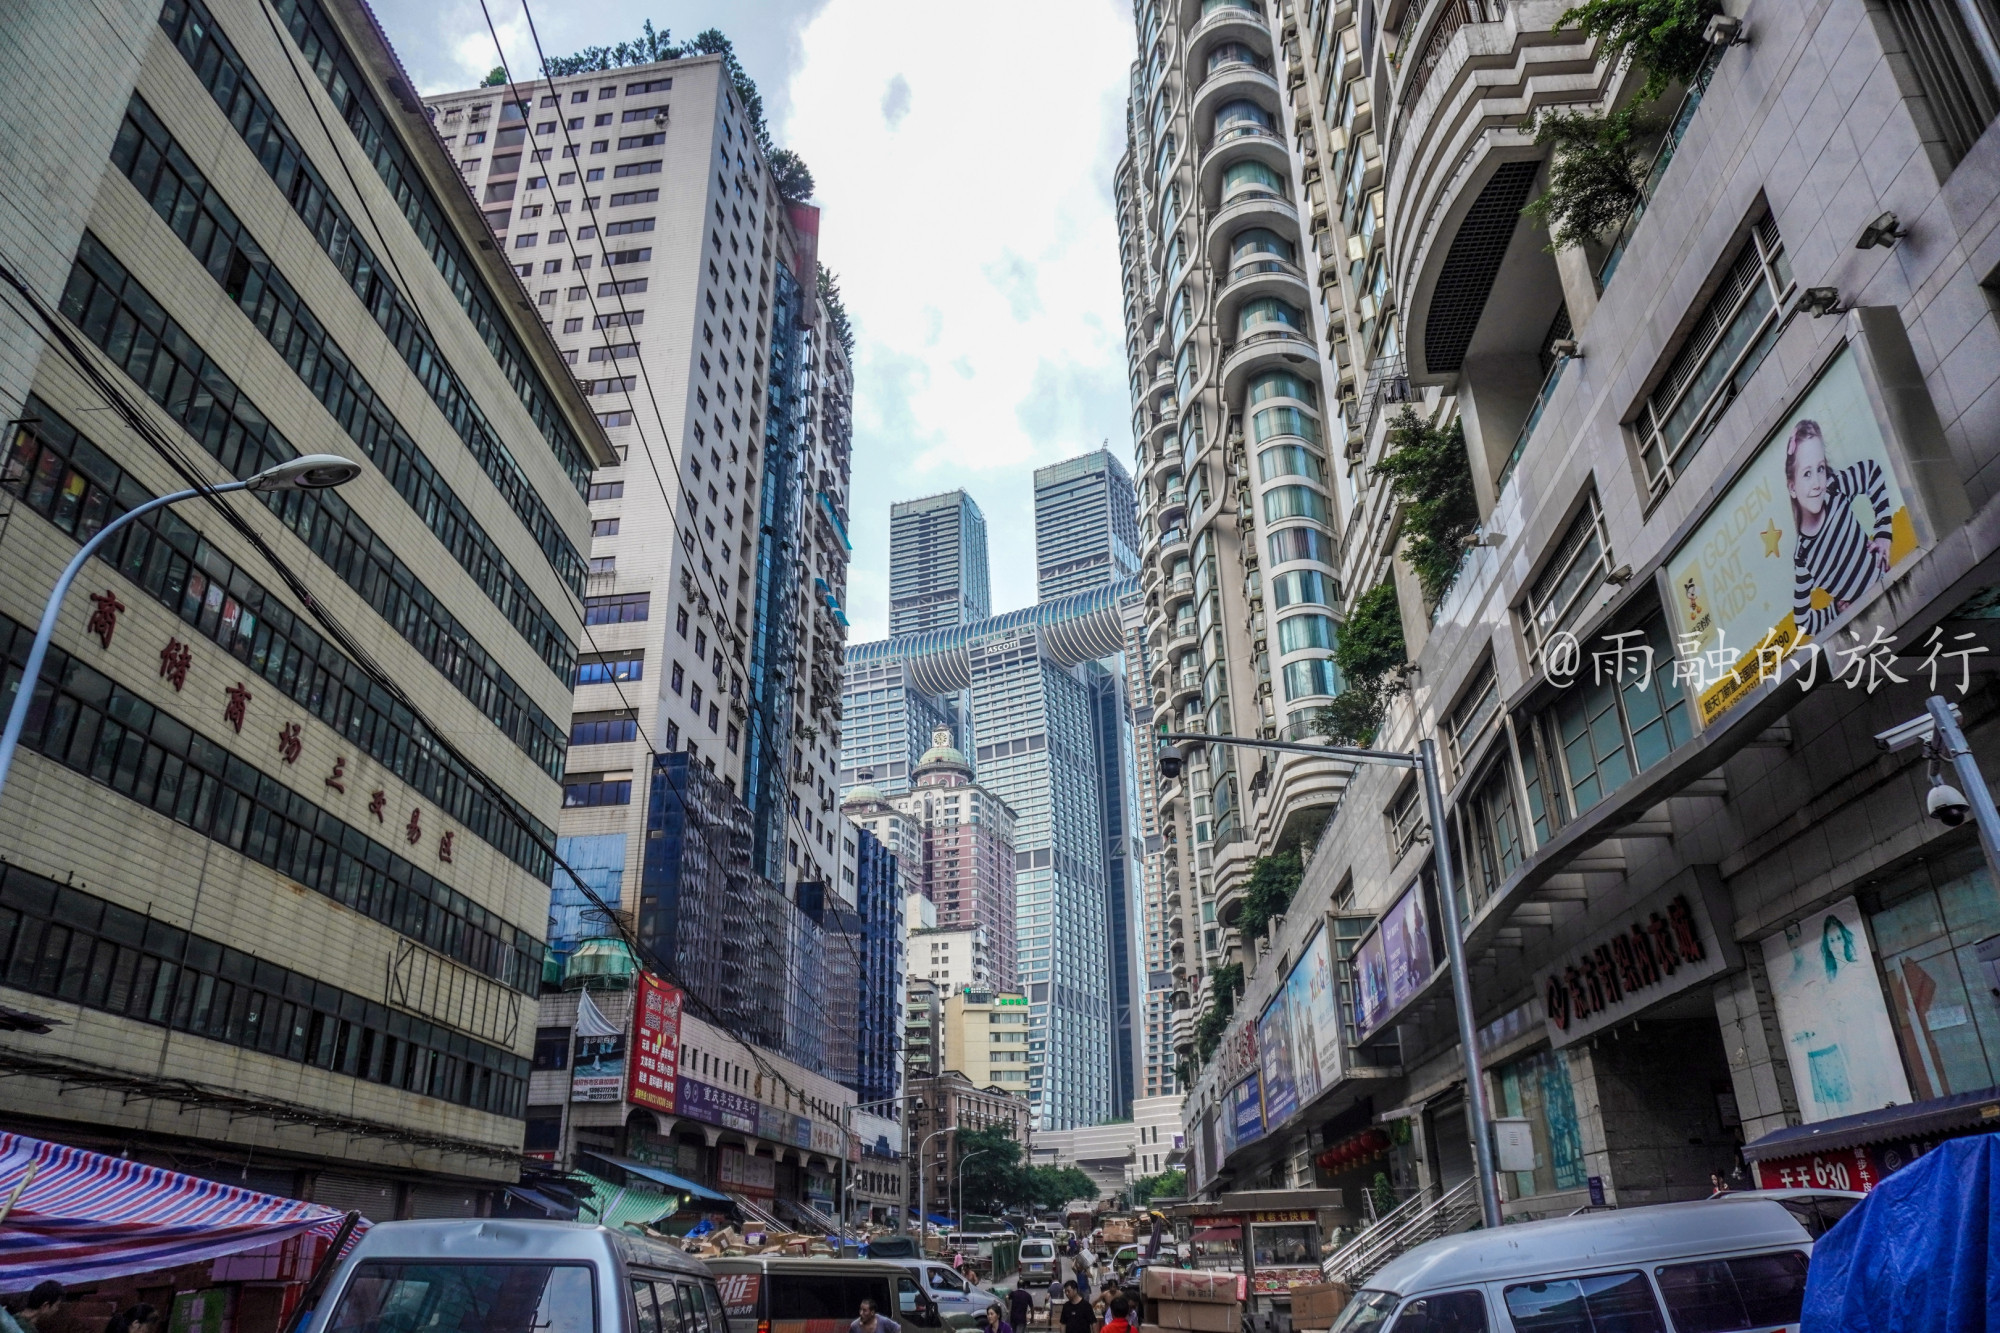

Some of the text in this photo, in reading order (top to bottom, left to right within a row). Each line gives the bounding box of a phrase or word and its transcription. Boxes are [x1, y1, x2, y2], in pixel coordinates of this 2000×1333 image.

[1702, 475, 1771, 571] GOLDEN
[1711, 546, 1746, 599] ANT
[1716, 575, 1758, 627] KIDS
[987, 641, 1018, 654] ASCOTT
[88, 589, 455, 864] 商储商场三交易区
